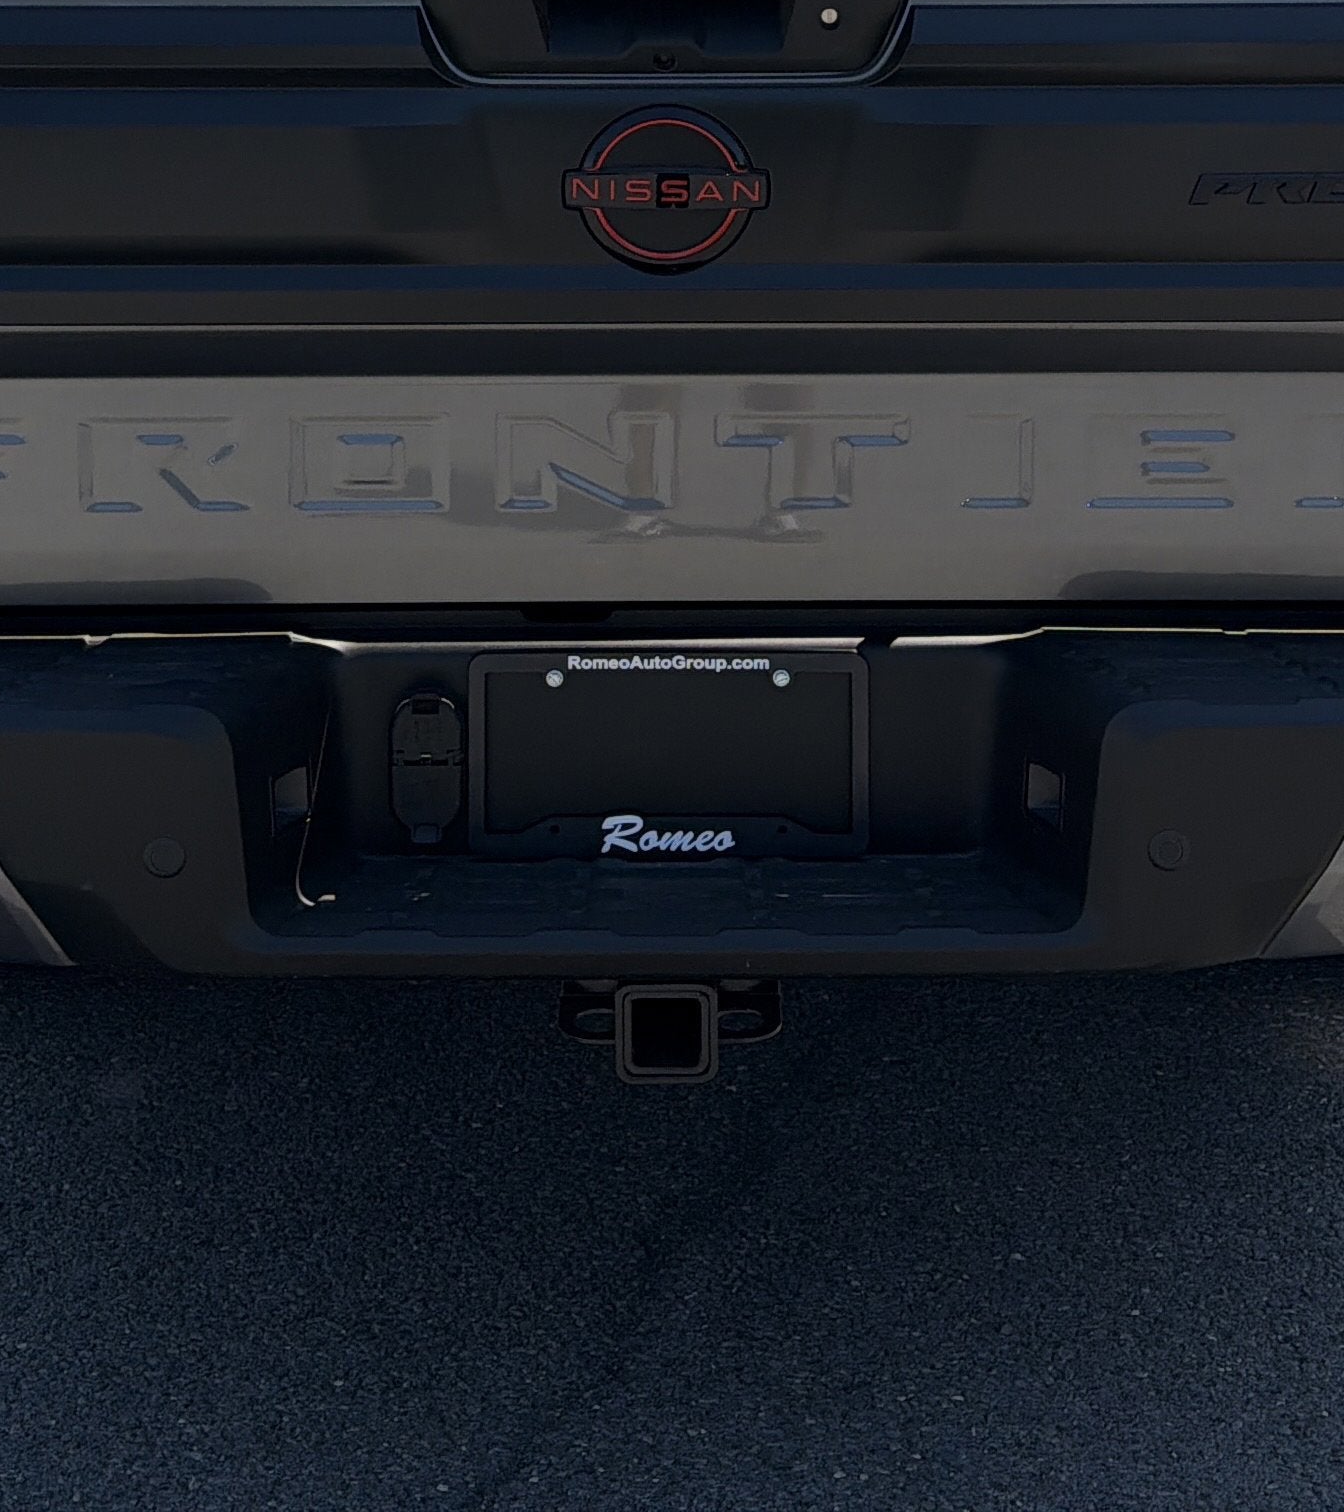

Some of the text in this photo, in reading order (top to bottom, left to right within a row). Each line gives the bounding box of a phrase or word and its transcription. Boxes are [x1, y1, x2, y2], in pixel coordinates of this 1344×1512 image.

[571, 177, 761, 202] NISSAN
[567, 655, 770, 672] RomeoAutoGroup.com
[601, 814, 736, 854] Romeo
